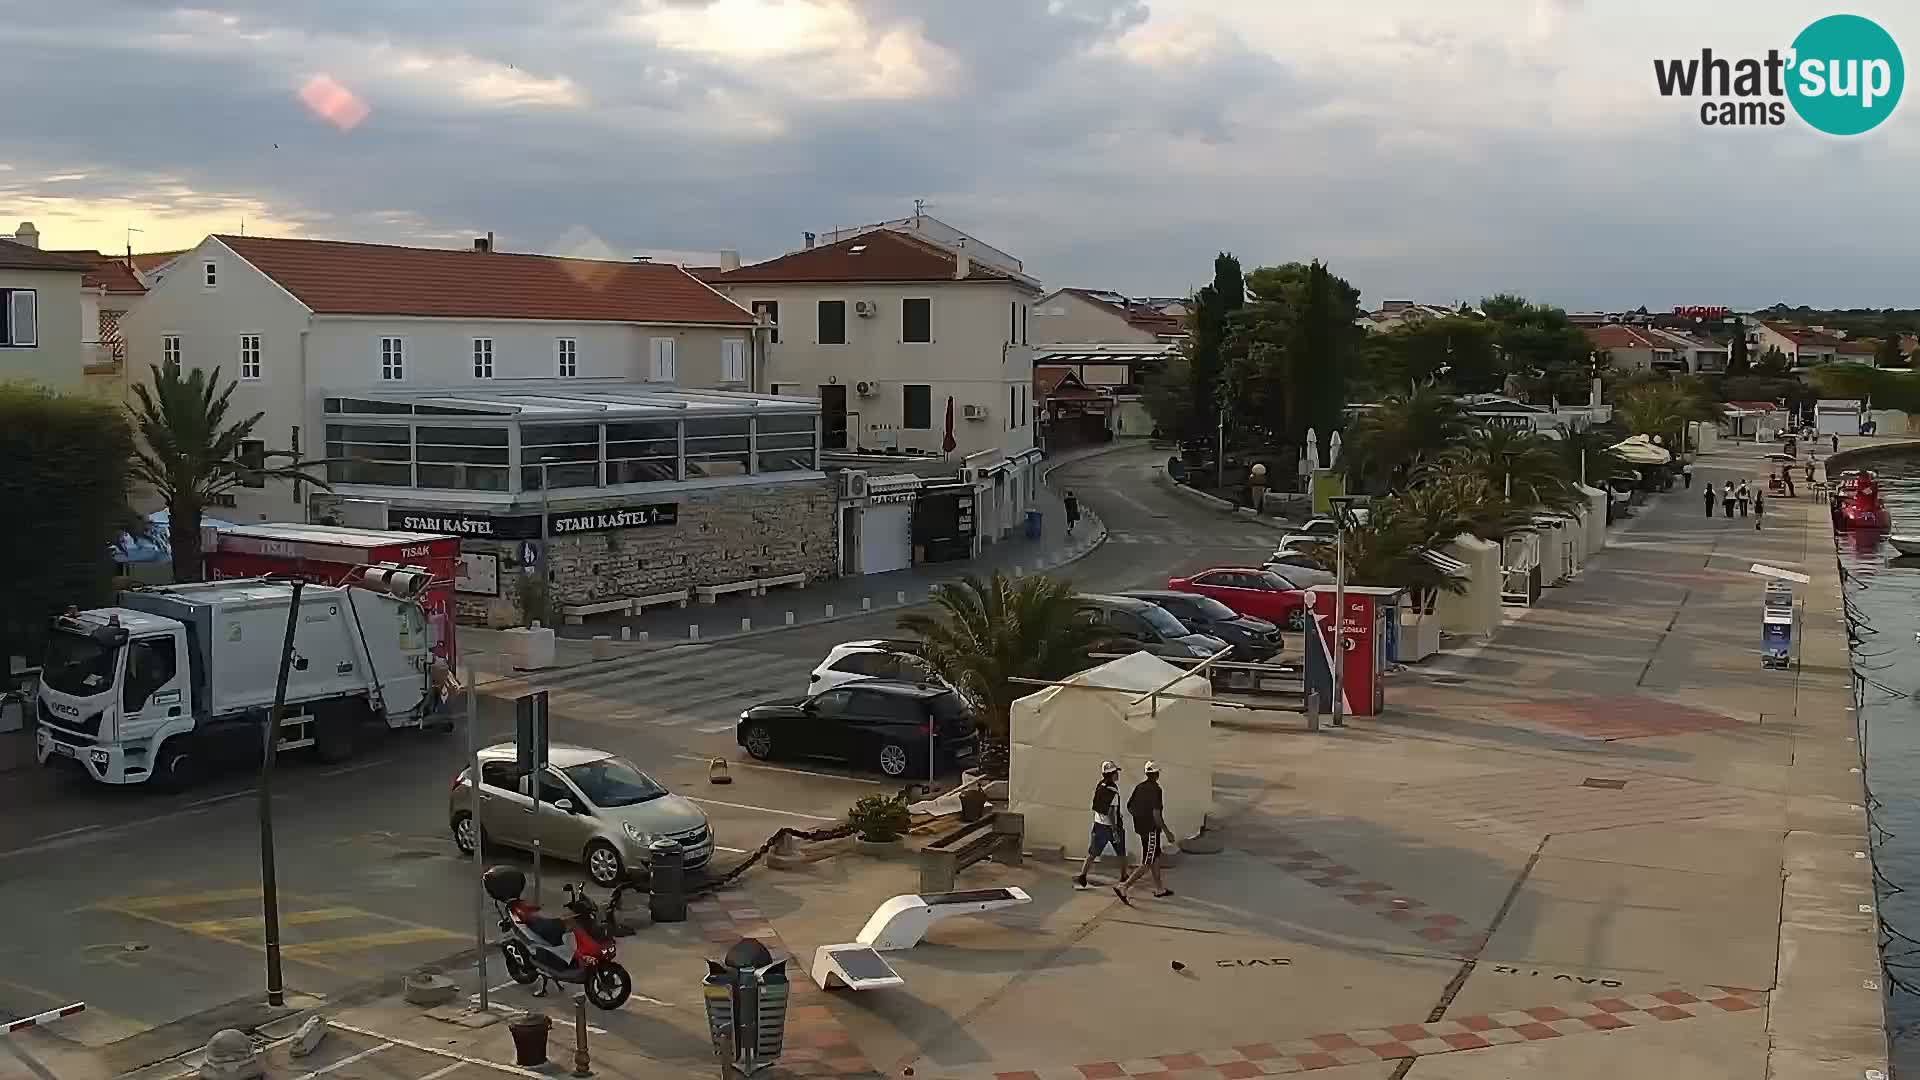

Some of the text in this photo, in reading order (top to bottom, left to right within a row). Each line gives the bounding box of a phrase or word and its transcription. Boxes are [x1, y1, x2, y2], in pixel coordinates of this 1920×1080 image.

[403, 516, 494, 534] STARI KAŠTEL
[555, 510, 648, 532] STARI KAŠTEL
[400, 545, 430, 559] TISAK
[1327, 625, 1368, 634] BAKOMAT
[51, 702, 80, 717] IVECO
